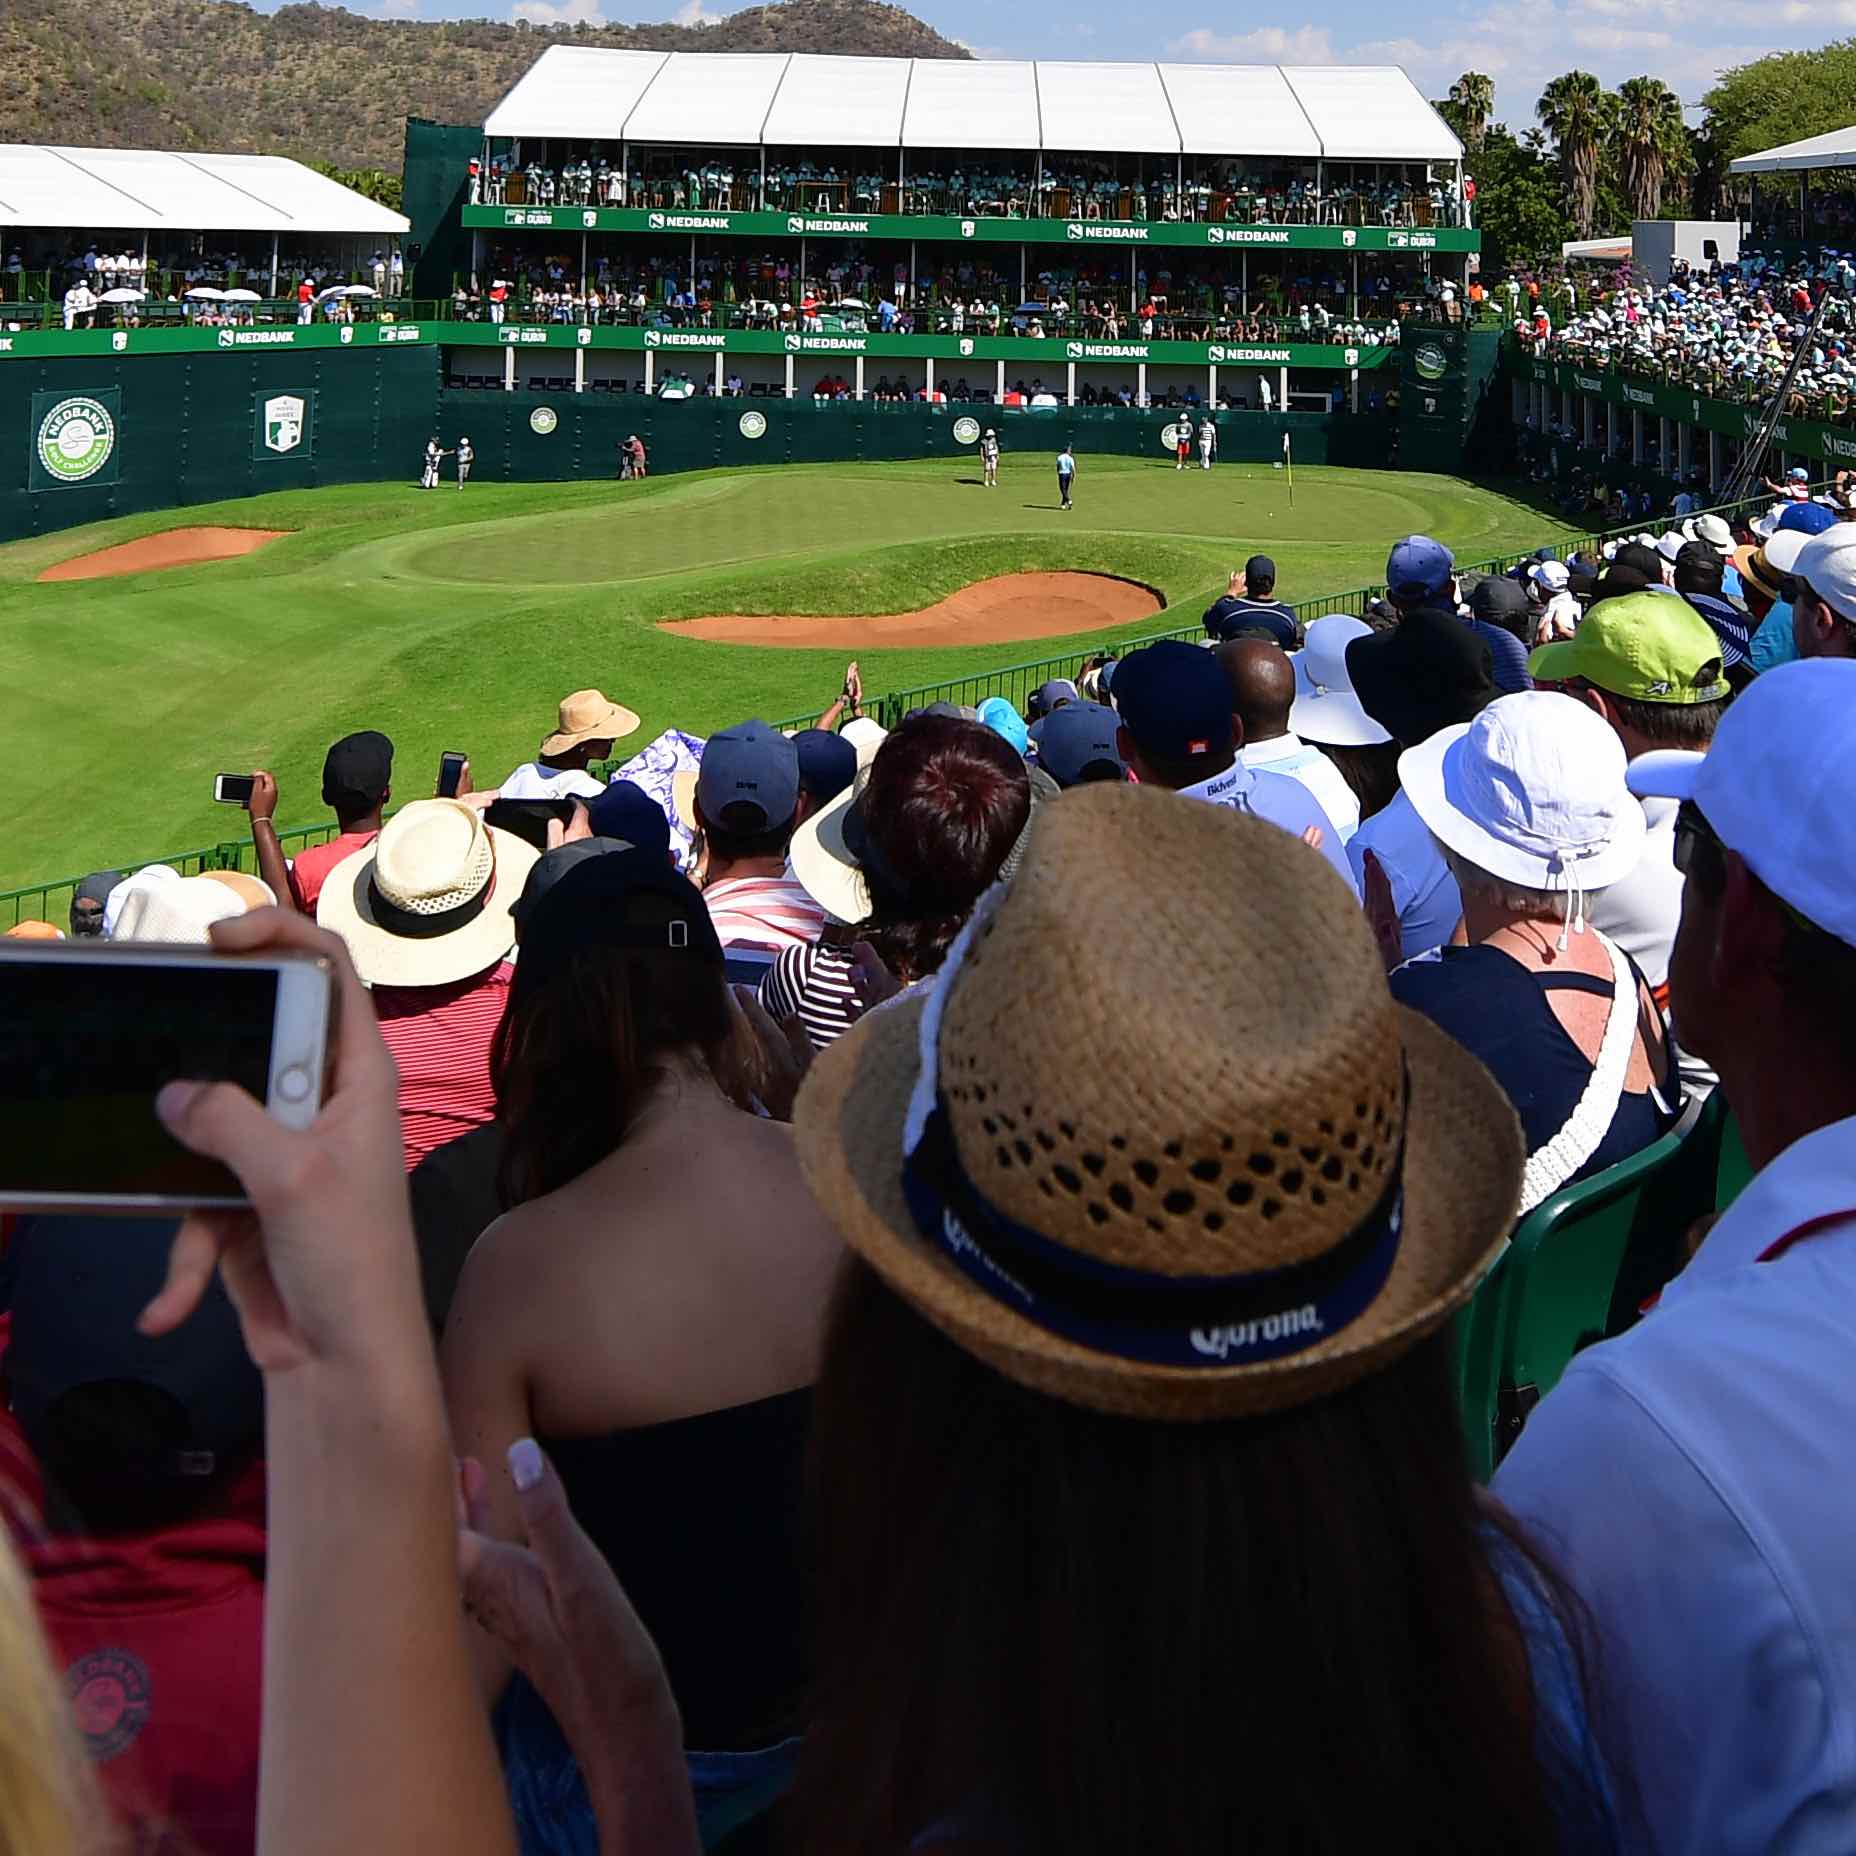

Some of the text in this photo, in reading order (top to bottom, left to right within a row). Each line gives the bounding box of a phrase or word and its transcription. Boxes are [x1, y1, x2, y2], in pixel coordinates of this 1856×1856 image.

[667, 216, 730, 229] NEDBANK
[805, 220, 869, 233] NEDBANK
[1085, 226, 1149, 239] NEDBANK
[1226, 230, 1289, 242] NEDBANK
[235, 331, 295, 344] NEDBANK
[662, 333, 726, 347] NEDBANK
[802, 337, 867, 350] NEDBANK
[1085, 344, 1149, 358] NEDBANK
[1227, 348, 1290, 361] NEDBANK
[48, 406, 106, 437] NEDBANK
[1190, 1304, 1318, 1359] Corona
